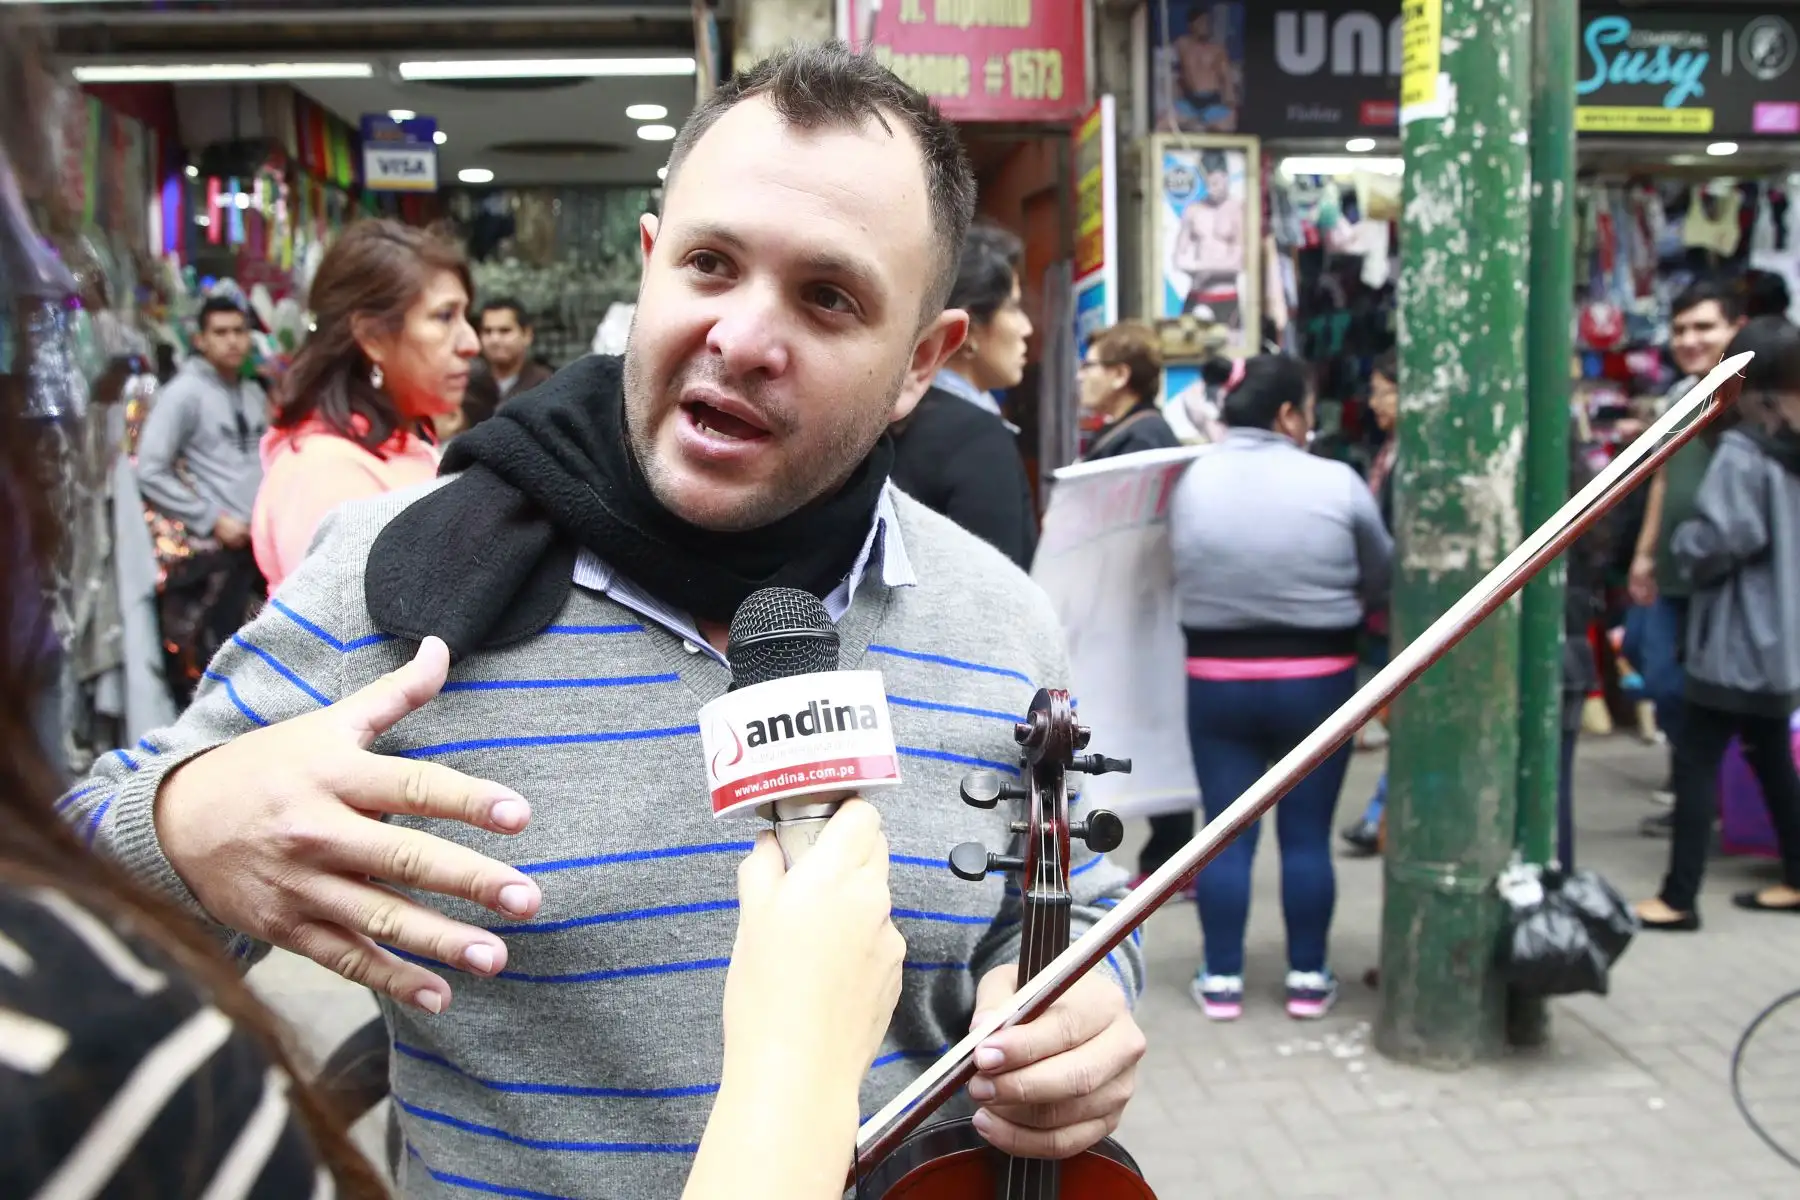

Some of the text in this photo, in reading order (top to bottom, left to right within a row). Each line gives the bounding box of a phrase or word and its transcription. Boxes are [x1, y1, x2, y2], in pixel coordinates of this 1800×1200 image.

[1575, 15, 1710, 110] Susy
[377, 157, 426, 176] VISA
[746, 699, 878, 748] andina
[734, 763, 855, 798] www.andina.com.pe
